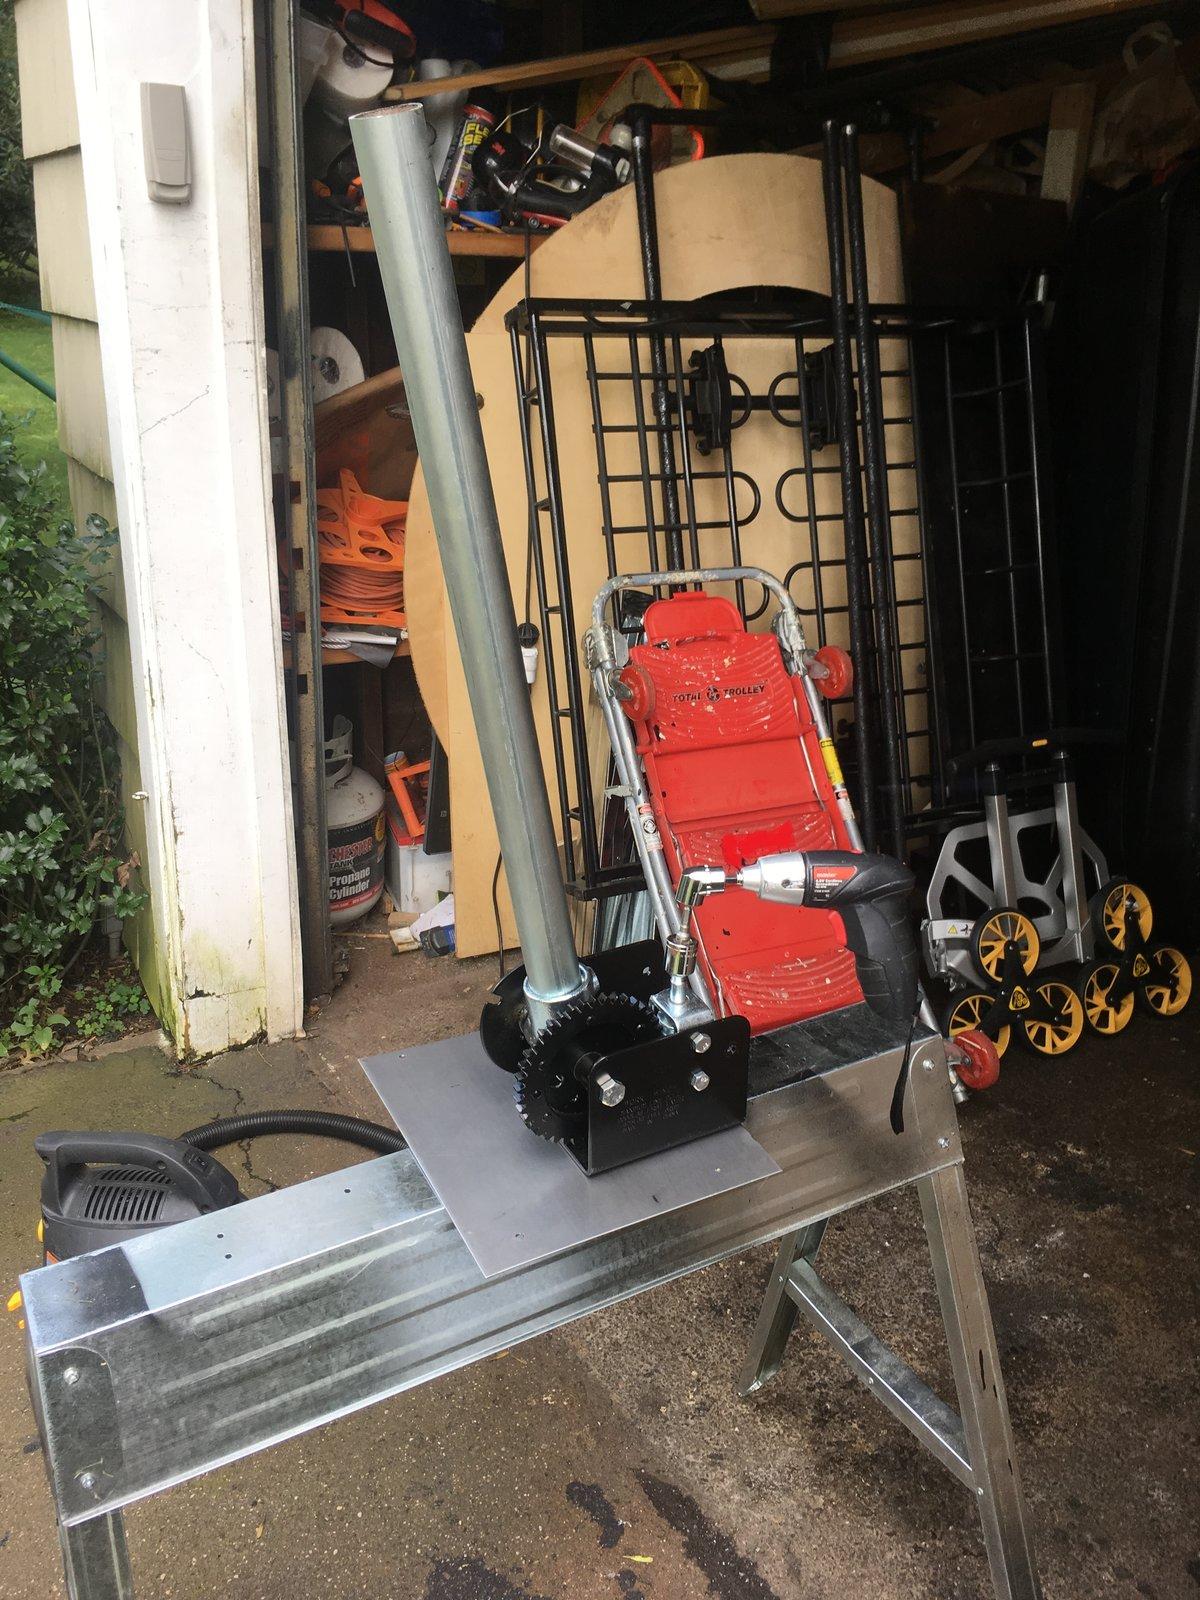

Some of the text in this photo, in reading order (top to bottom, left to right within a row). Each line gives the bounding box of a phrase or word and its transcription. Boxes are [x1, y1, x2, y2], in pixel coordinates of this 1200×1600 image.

[723, 685, 765, 697] TROLLEY
[330, 867, 371, 887] Propane
[329, 879, 370, 900] Cylinder
